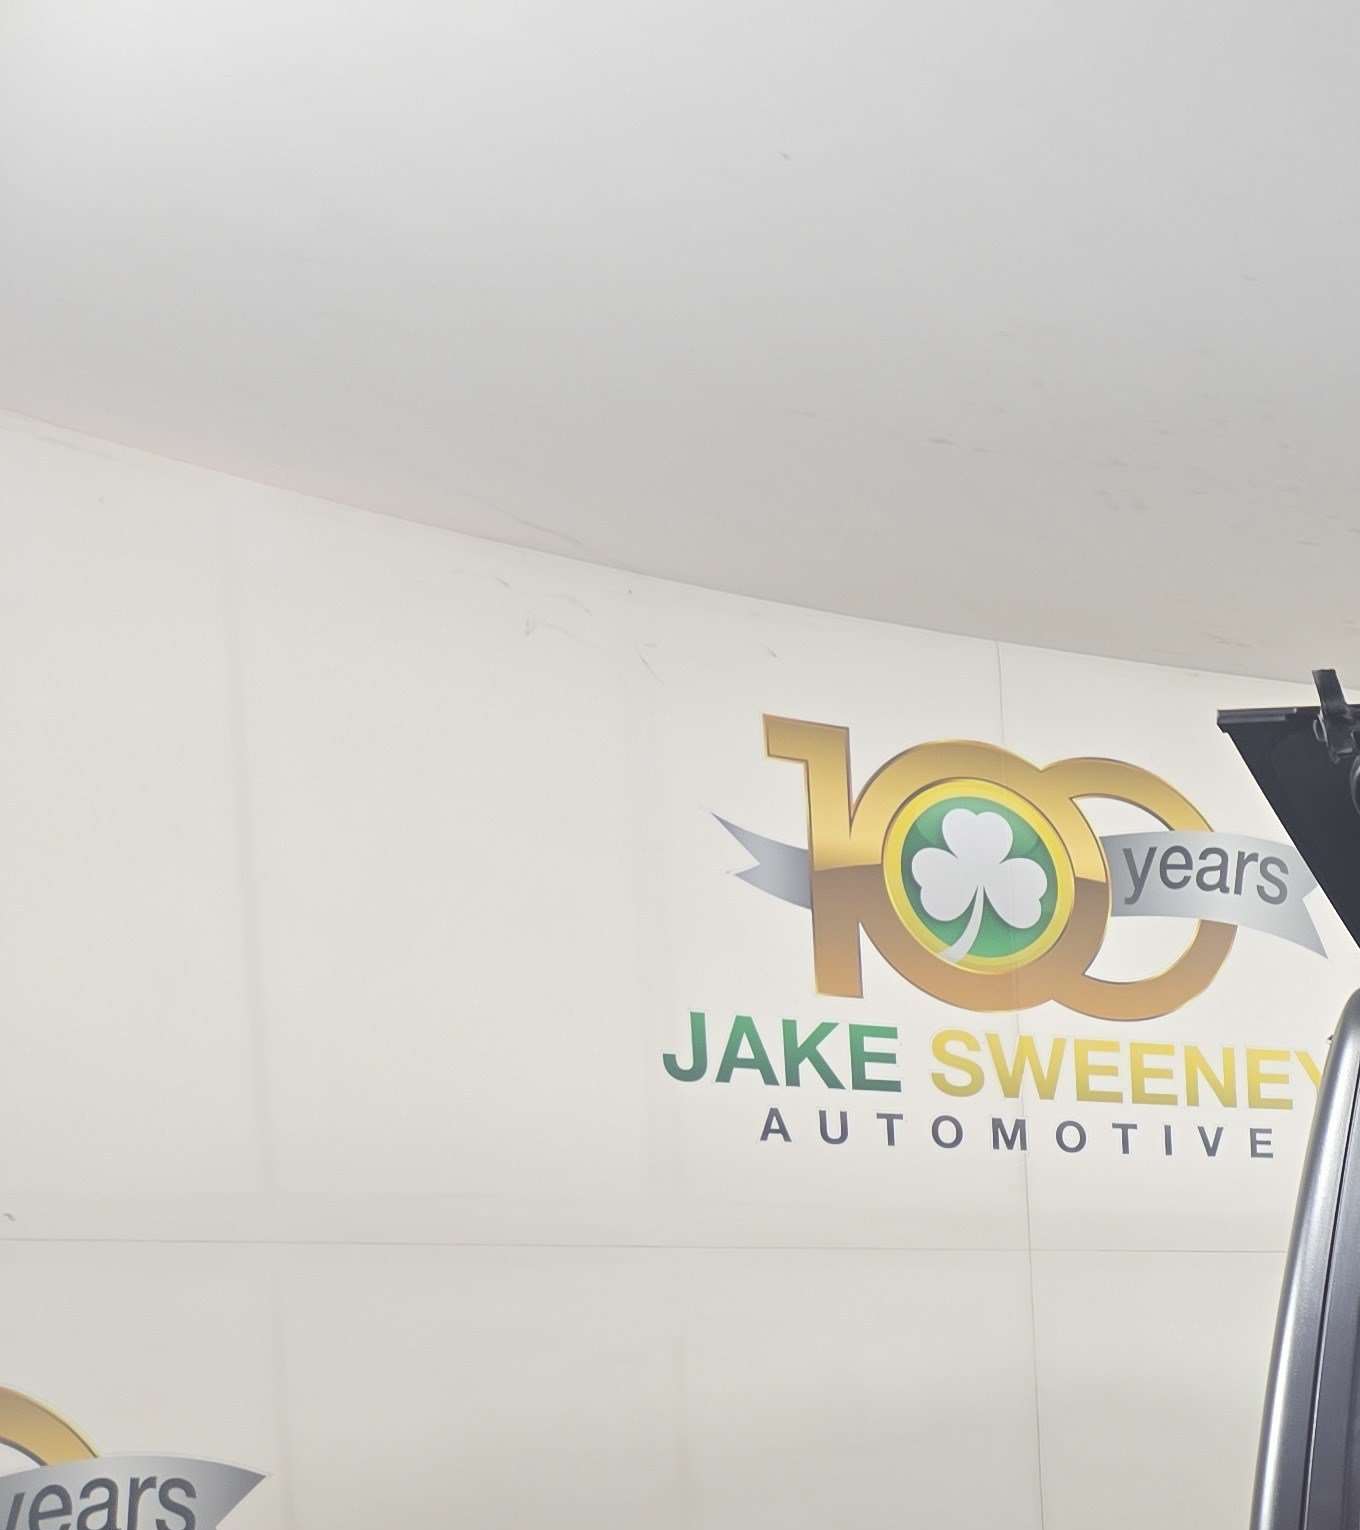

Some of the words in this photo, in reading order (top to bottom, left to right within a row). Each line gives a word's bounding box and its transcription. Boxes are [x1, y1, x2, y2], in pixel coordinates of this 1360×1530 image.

[763, 714, 1239, 1022] 100
[1122, 843, 1291, 905] years
[662, 1011, 902, 1093] JAKE
[760, 1107, 1275, 1160] AUTOMOTIVE
